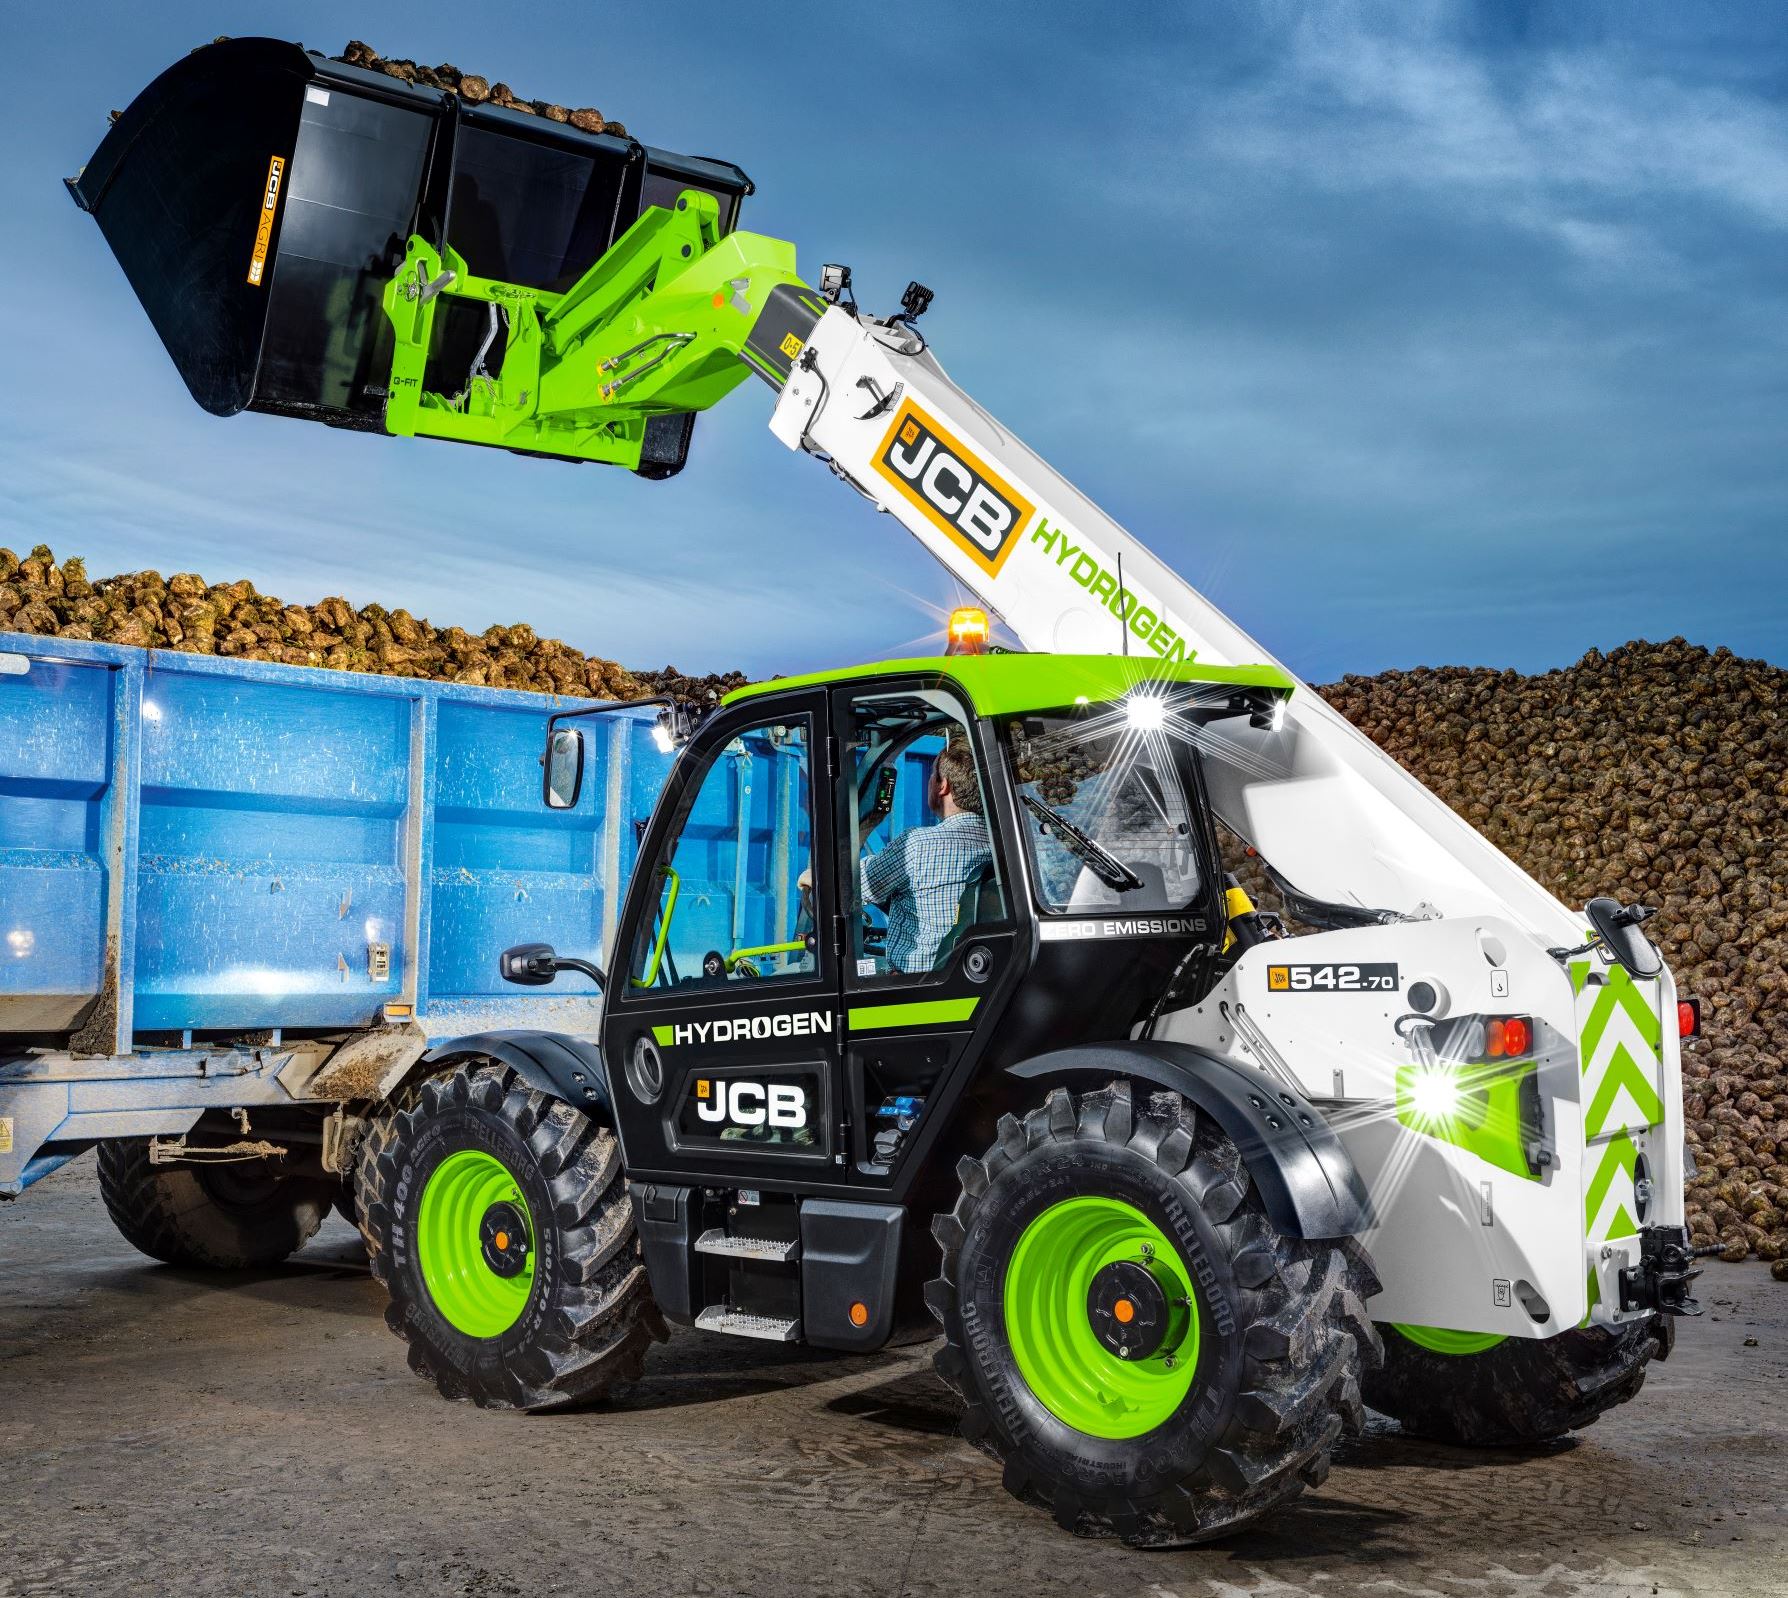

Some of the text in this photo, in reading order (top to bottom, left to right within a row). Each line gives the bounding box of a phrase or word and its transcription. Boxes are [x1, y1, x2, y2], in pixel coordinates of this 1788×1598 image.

[255, 160, 281, 260] JCB AGRI
[393, 376, 419, 388] Q-FIT
[890, 436, 1012, 551] JCB
[1103, 918, 1207, 936] EMISSIONS
[675, 1010, 832, 1046] HYDROGEN
[697, 1080, 807, 1128] JCB
[1158, 1187, 1238, 1338] TRELLEBORG
[960, 1301, 1030, 1448] TRELLEBORG
